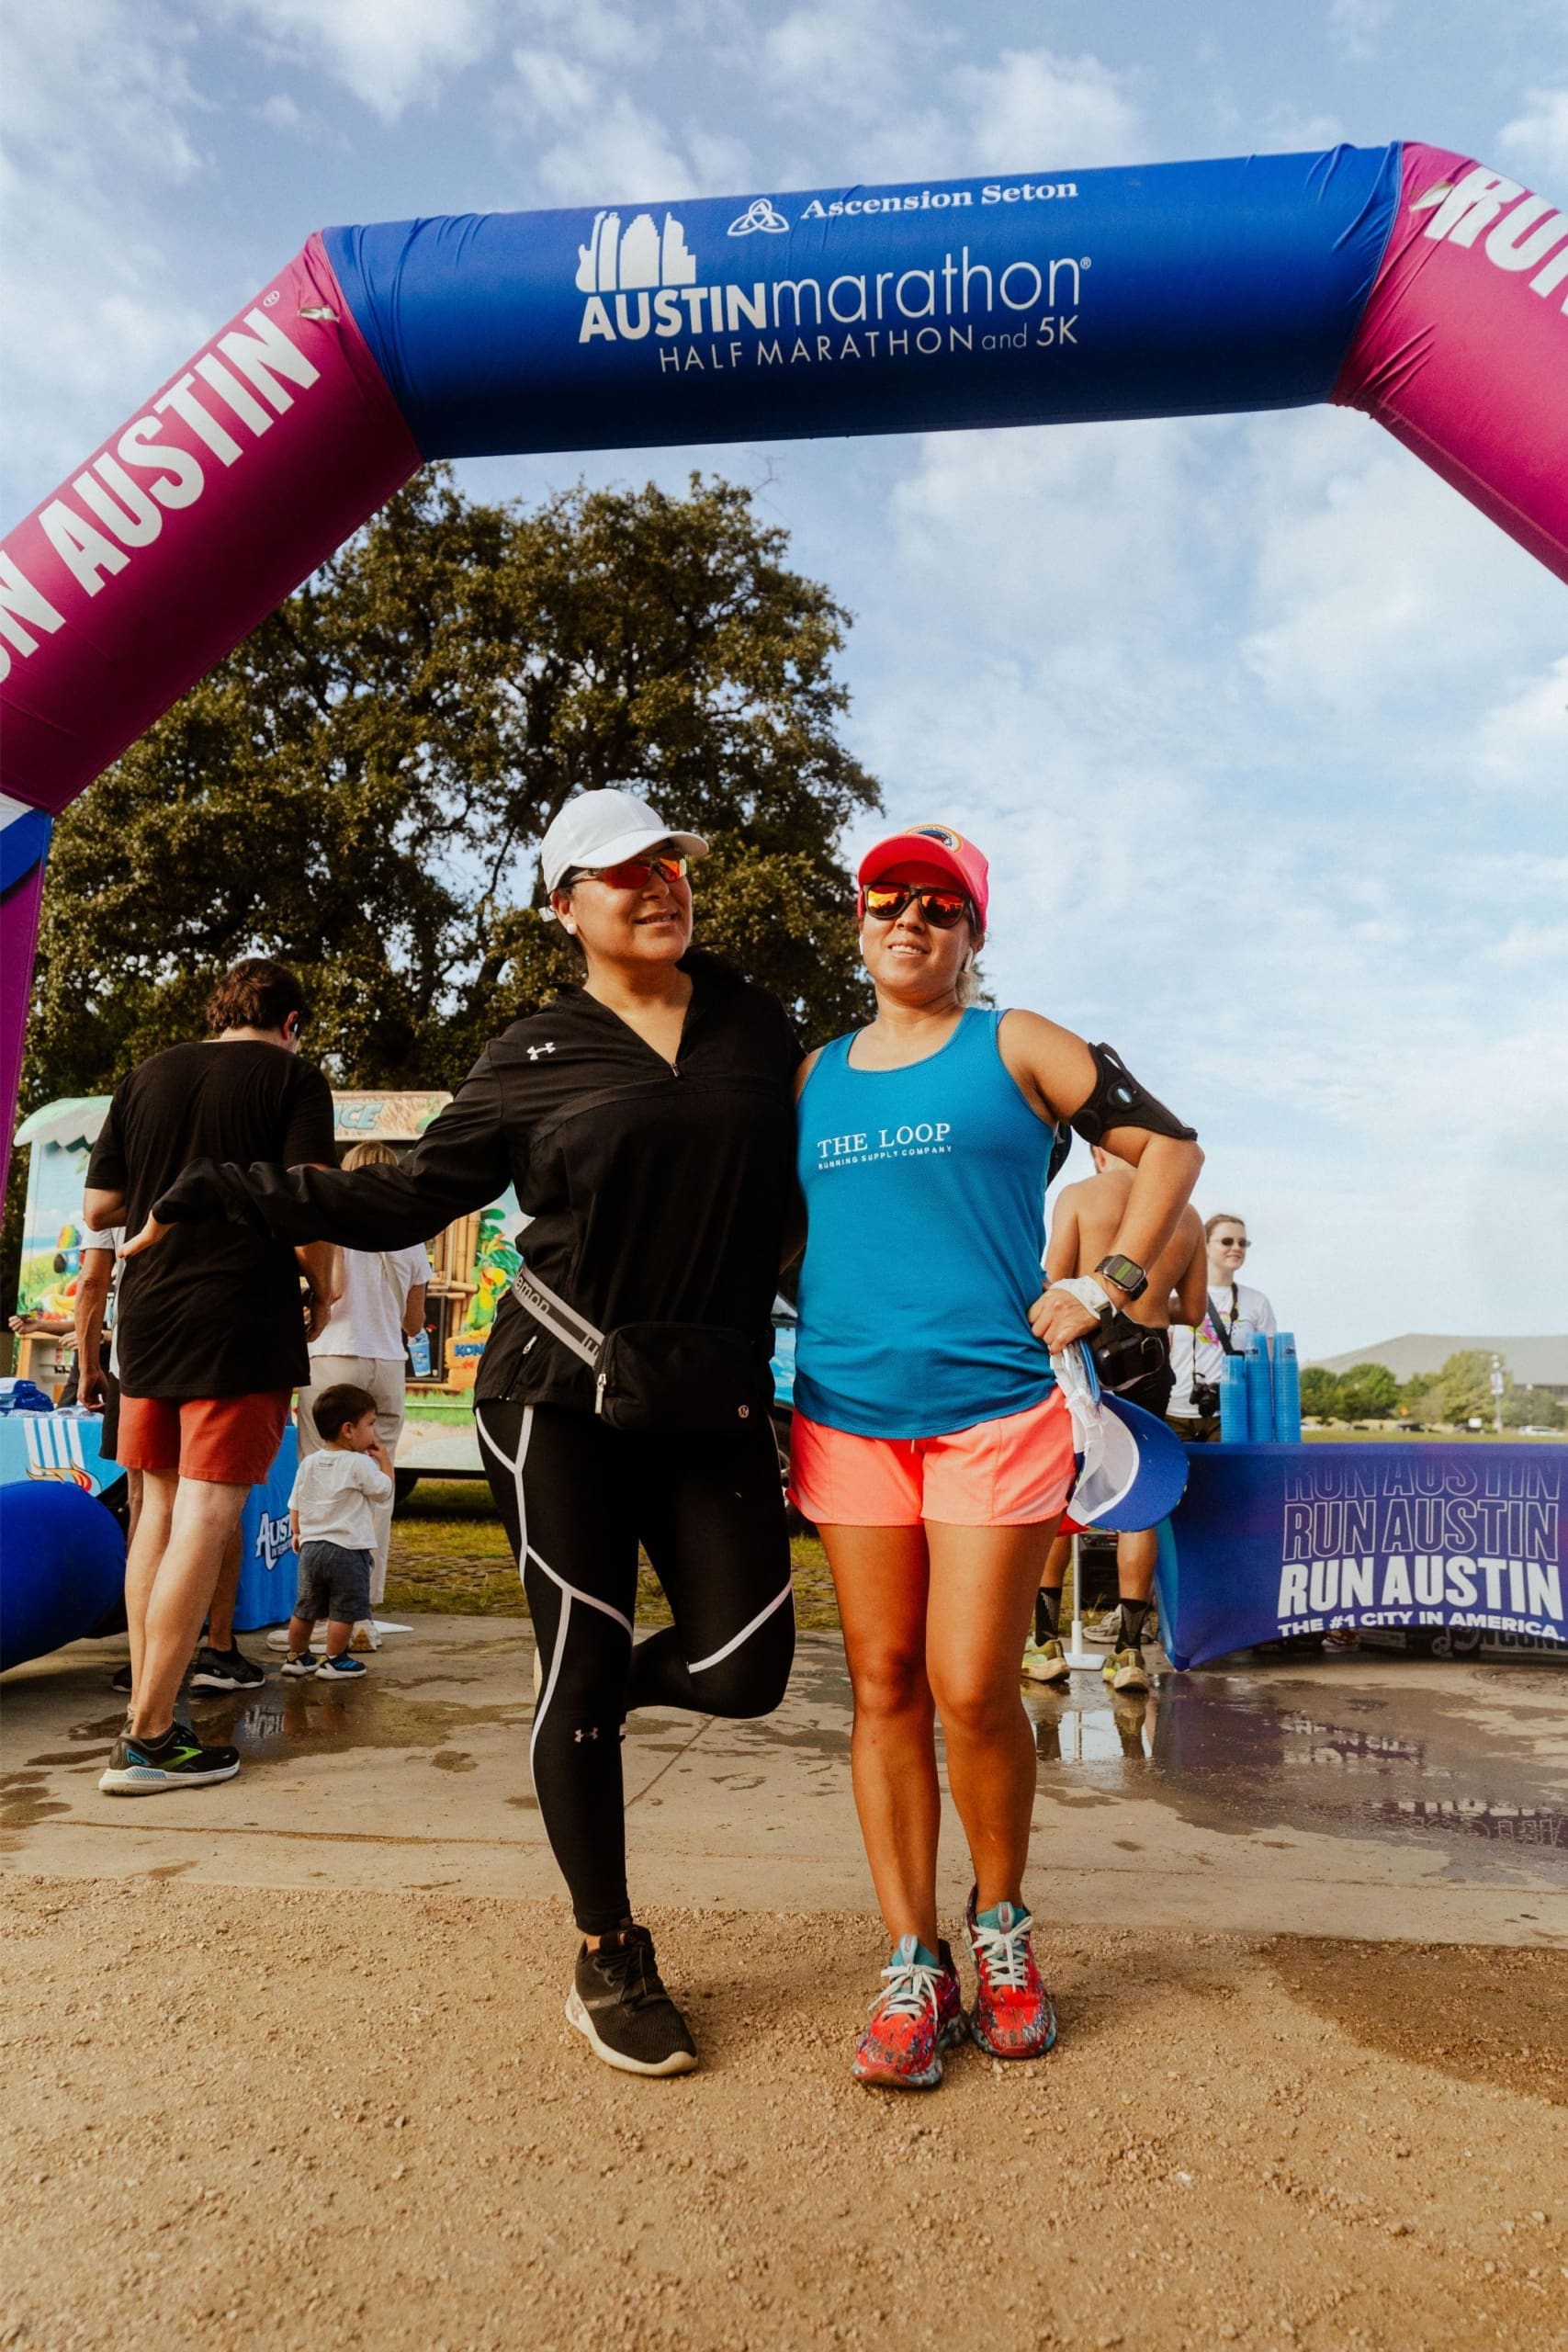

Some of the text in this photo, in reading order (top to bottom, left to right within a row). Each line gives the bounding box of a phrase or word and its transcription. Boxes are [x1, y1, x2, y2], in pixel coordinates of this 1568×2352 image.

[800, 183, 1078, 220] Ascension Seton
[660, 315, 1079, 373] HALF MARATHON and 5K
[0, 548, 66, 685] N
[818, 1123, 951, 1159] THE LOOP
[818, 1145, 953, 1170] RUNNING SUPPLY COMPANY
[1285, 1458, 1562, 1501] RUN AUSTIN
[1282, 1498, 1559, 1562] RUN AUSTIN
[1278, 1555, 1564, 1622] RUN AUSTIN
[1278, 1618, 1324, 1638] THE
[1329, 1613, 1356, 1631] #1
[1360, 1611, 1414, 1627] CITY
[1419, 1611, 1444, 1625] IN
[1449, 1611, 1566, 1642] AMERICA.
